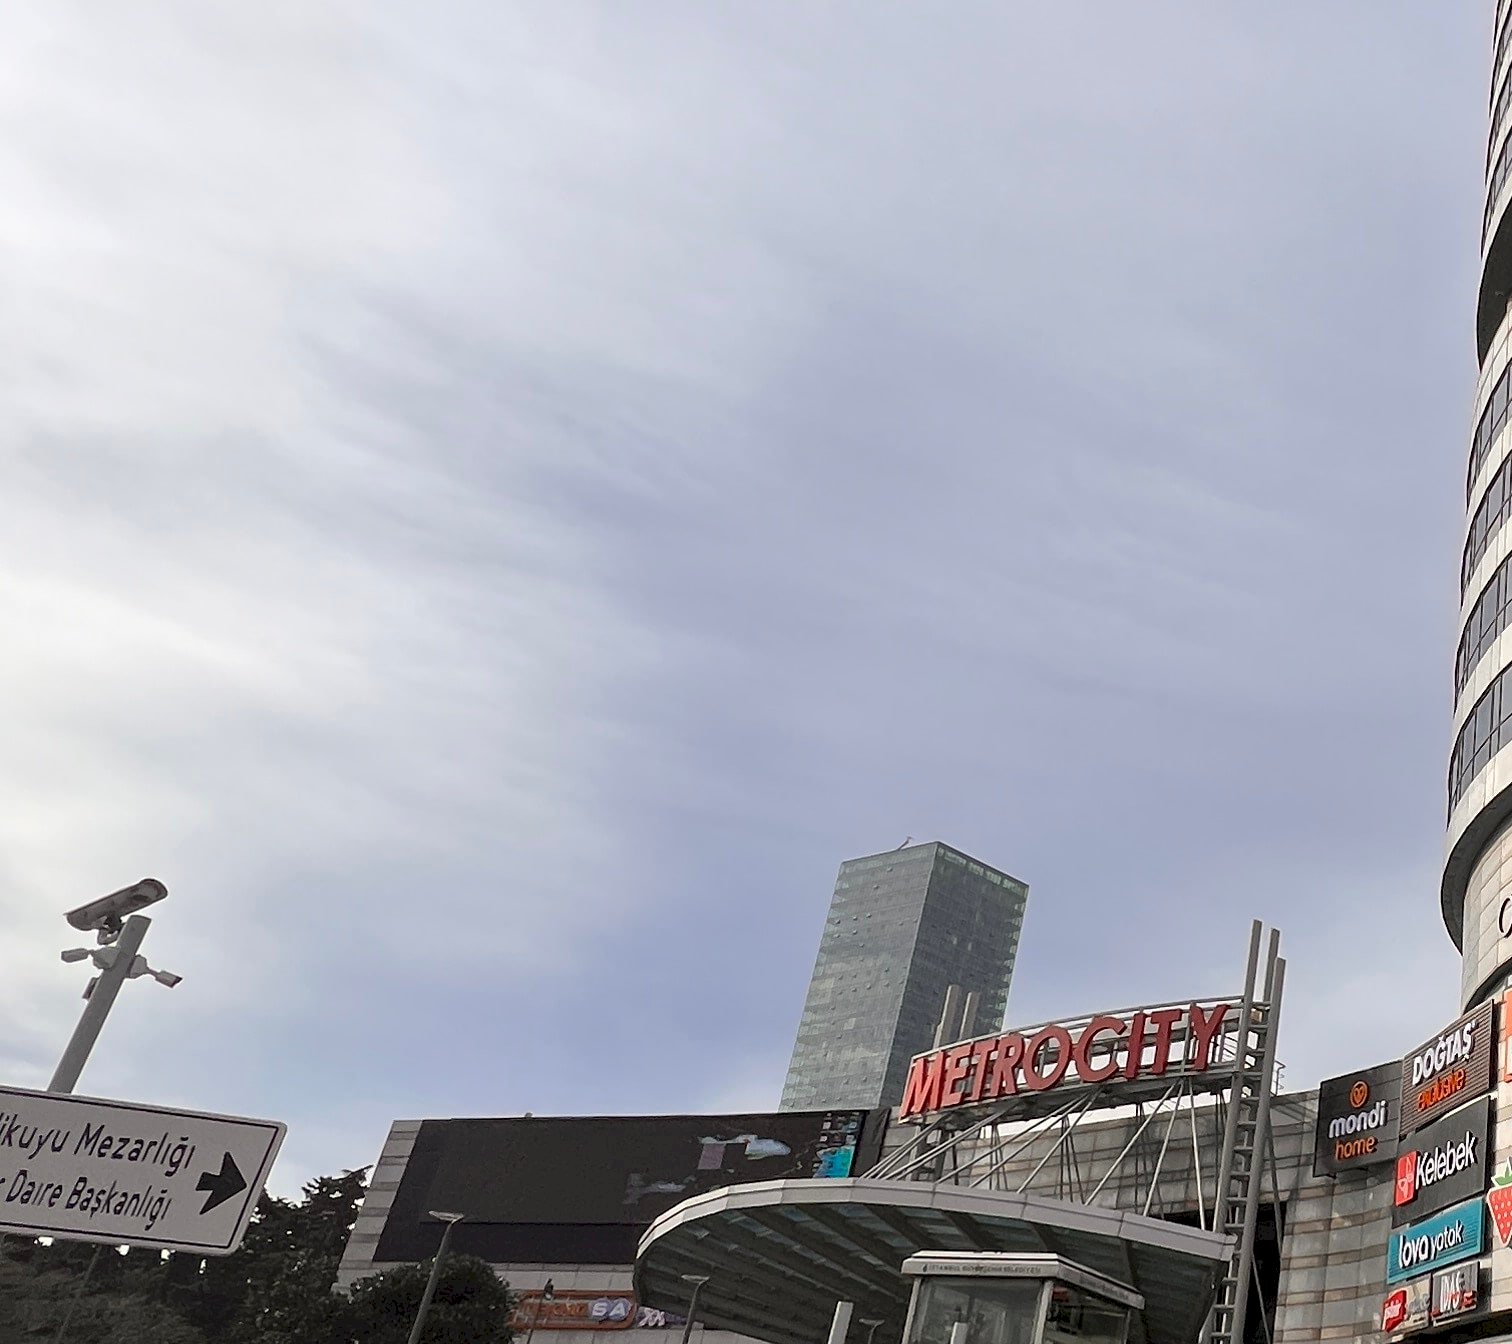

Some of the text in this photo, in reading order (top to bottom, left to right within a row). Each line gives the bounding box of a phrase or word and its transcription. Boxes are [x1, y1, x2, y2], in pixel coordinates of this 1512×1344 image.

[901, 1002, 1230, 1117] METROCITY
[1411, 1024, 1474, 1086] DOĞTAŞ
[0, 1112, 196, 1177] ikuyu Mezarlığı
[1328, 1100, 1387, 1139] mondi
[1335, 1136, 1377, 1161] home
[1416, 1131, 1477, 1190] Kelebek
[65, 1176, 172, 1231] Başkanlığı
[1399, 1234, 1429, 1268] lova
